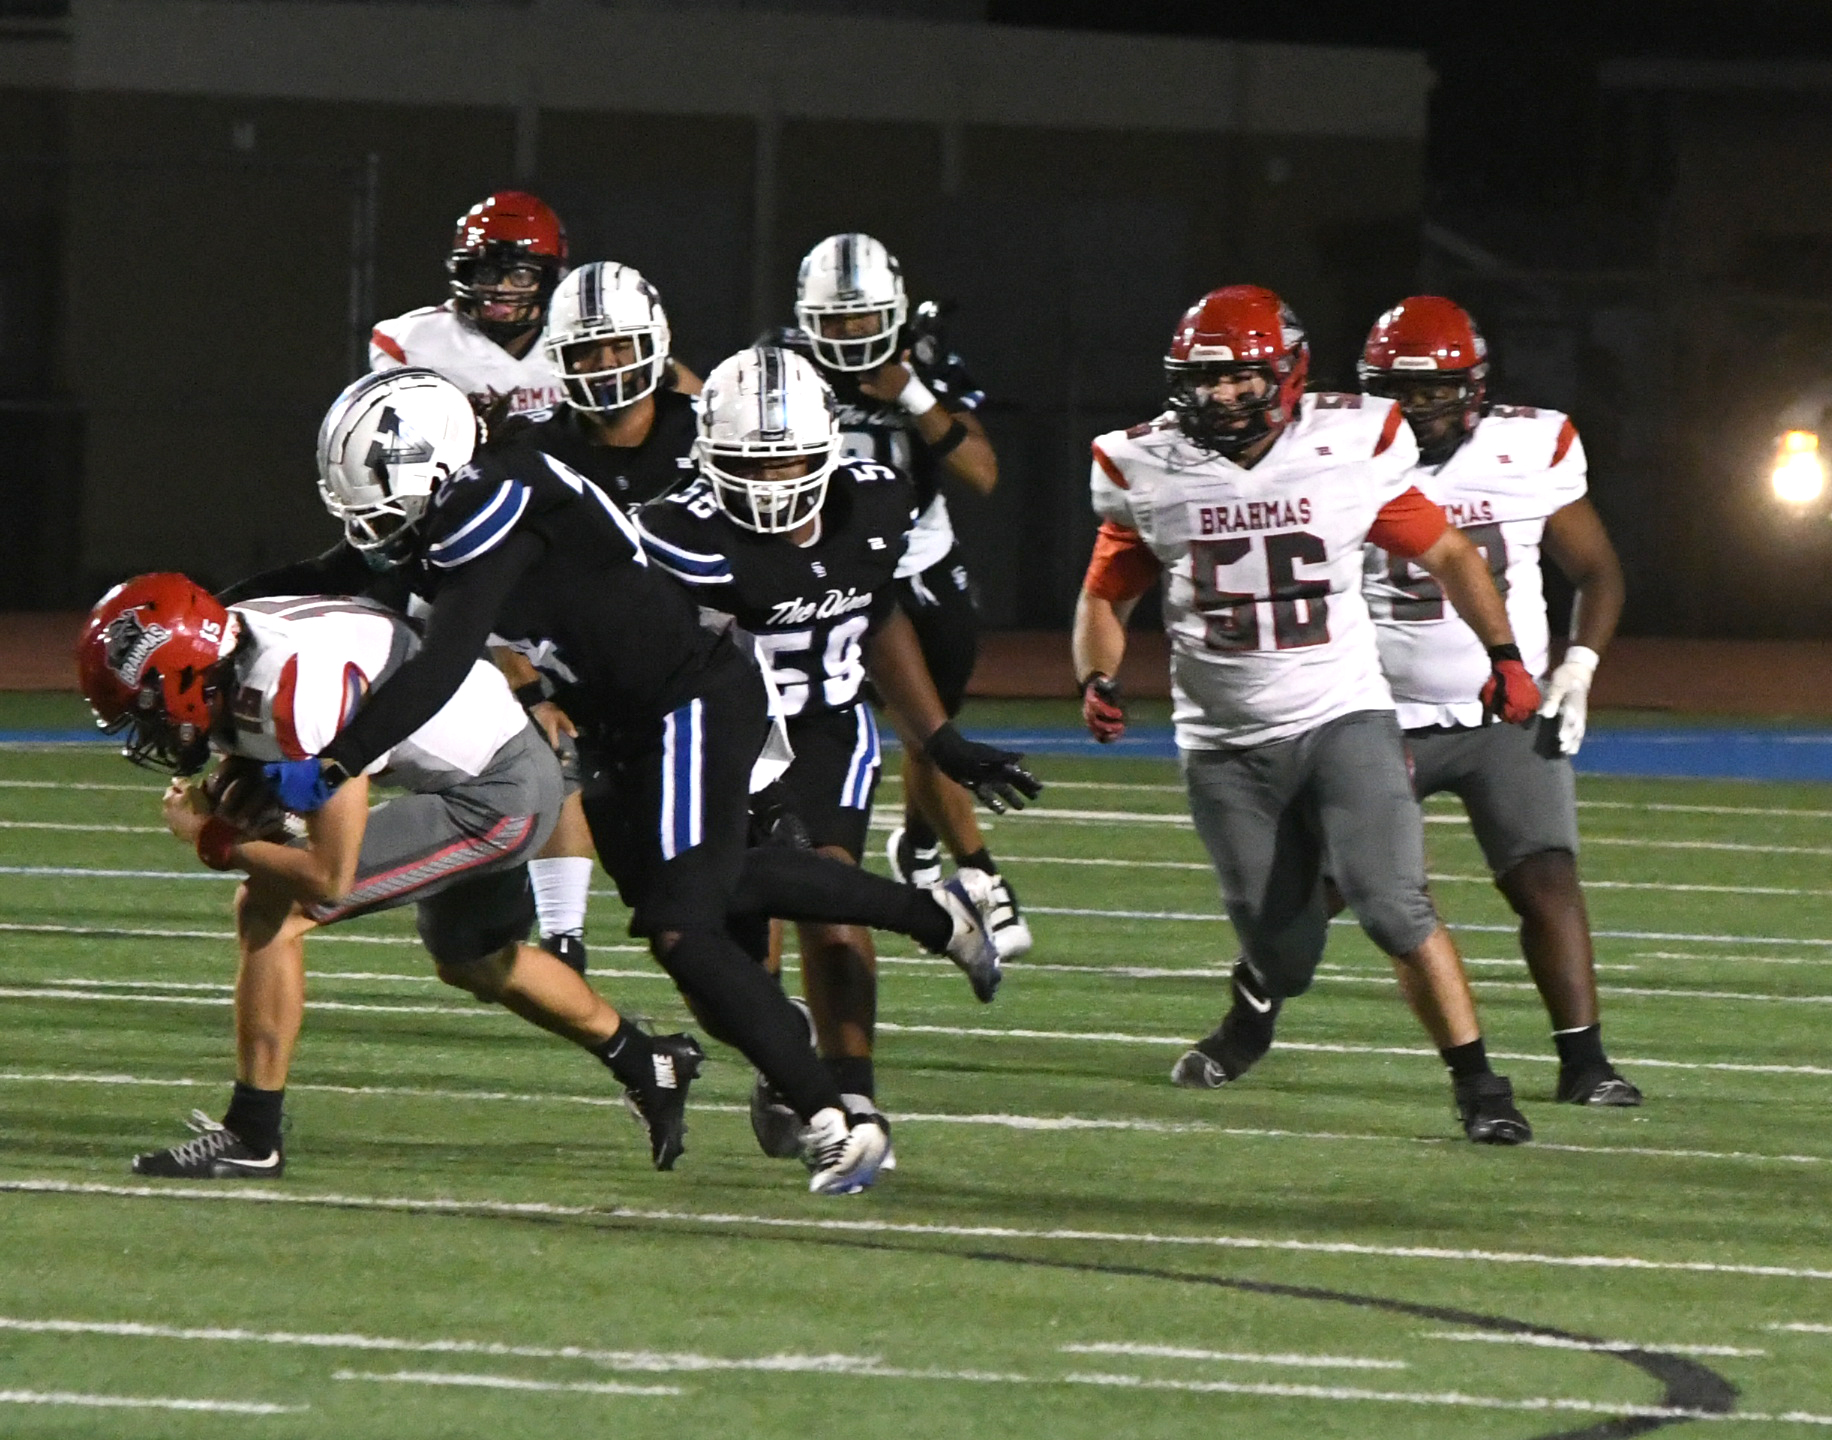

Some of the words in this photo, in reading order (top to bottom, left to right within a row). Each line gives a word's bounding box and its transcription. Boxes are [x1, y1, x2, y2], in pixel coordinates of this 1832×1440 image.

[1200, 498, 1311, 535] BRAHMAS
[1189, 531, 1332, 651] 56
[765, 597, 817, 625] The
[199, 618, 220, 643] 15
[119, 624, 171, 686] BRAHMAS
[652, 1053, 677, 1089] NIKE
